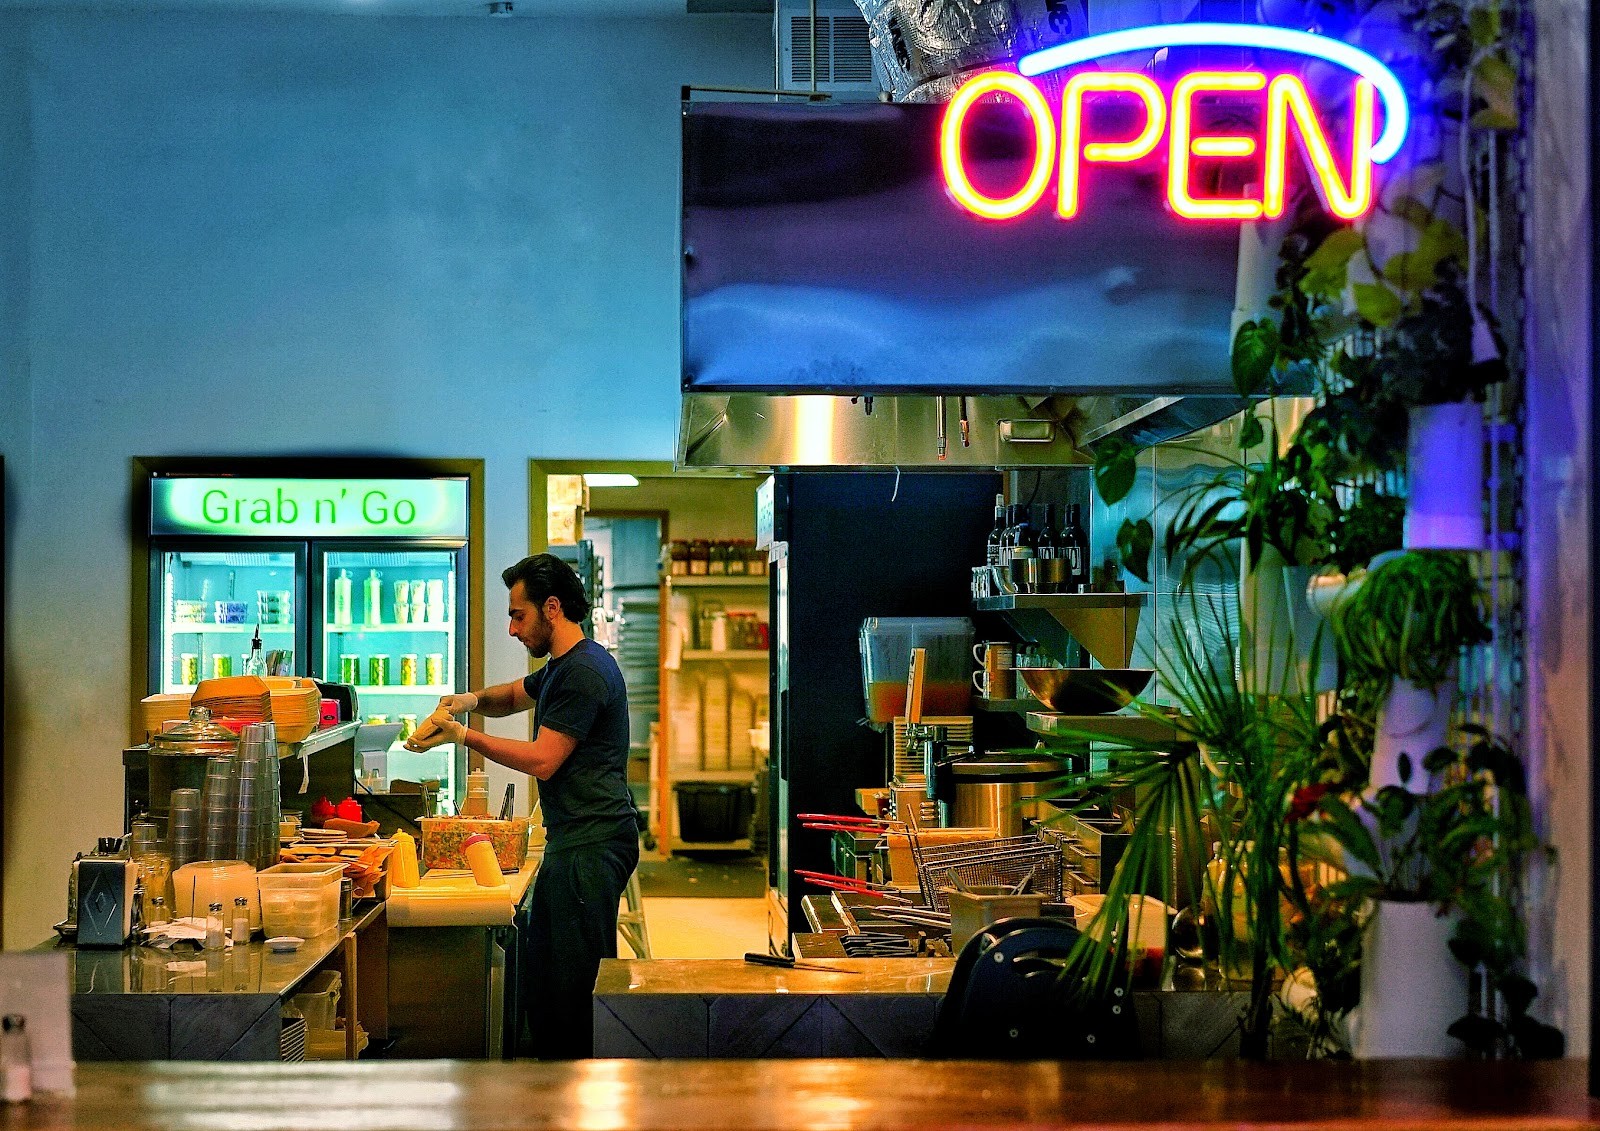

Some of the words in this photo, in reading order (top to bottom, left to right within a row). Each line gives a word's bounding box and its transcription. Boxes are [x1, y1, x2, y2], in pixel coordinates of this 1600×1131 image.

[940, 70, 1374, 220] OPEN
[202, 488, 298, 524] Grab
[362, 490, 416, 525] Go
